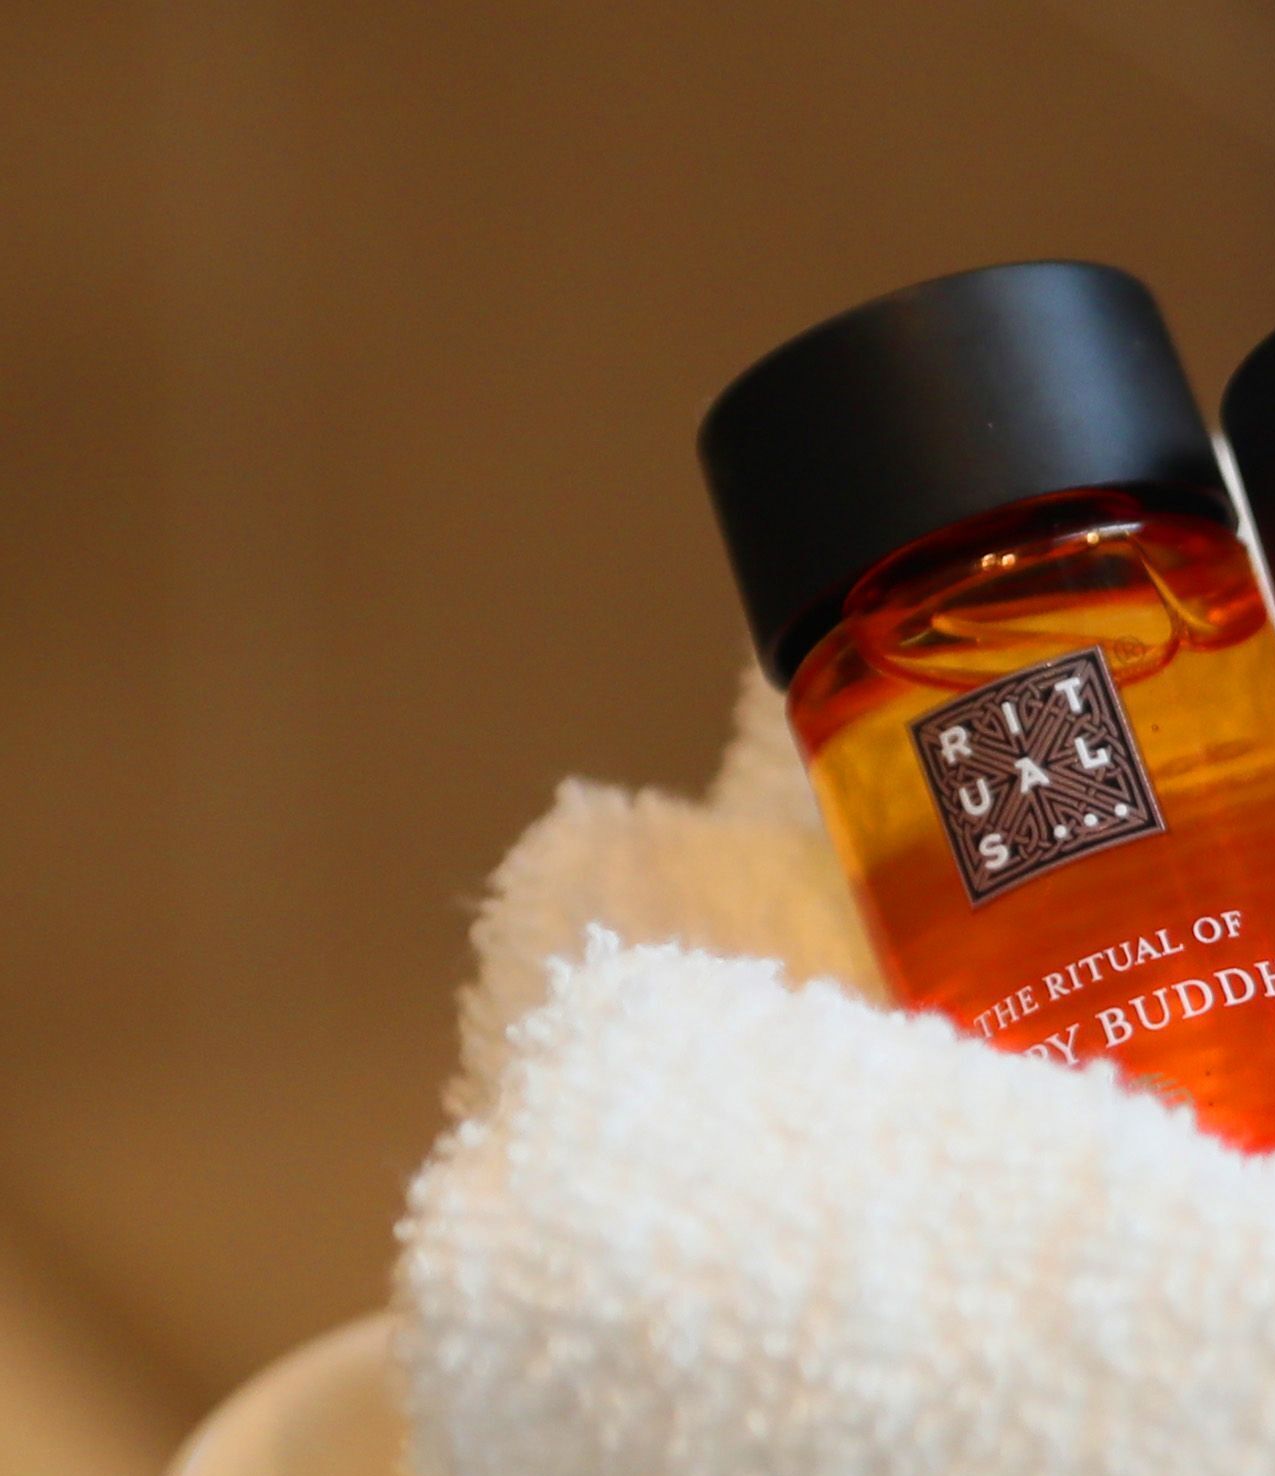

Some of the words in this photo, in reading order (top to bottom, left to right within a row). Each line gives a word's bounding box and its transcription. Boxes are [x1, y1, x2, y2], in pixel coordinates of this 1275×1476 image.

[973, 986, 1039, 1038] THE
[1042, 928, 1184, 1001] RITUAL
[1193, 911, 1244, 945] OF
